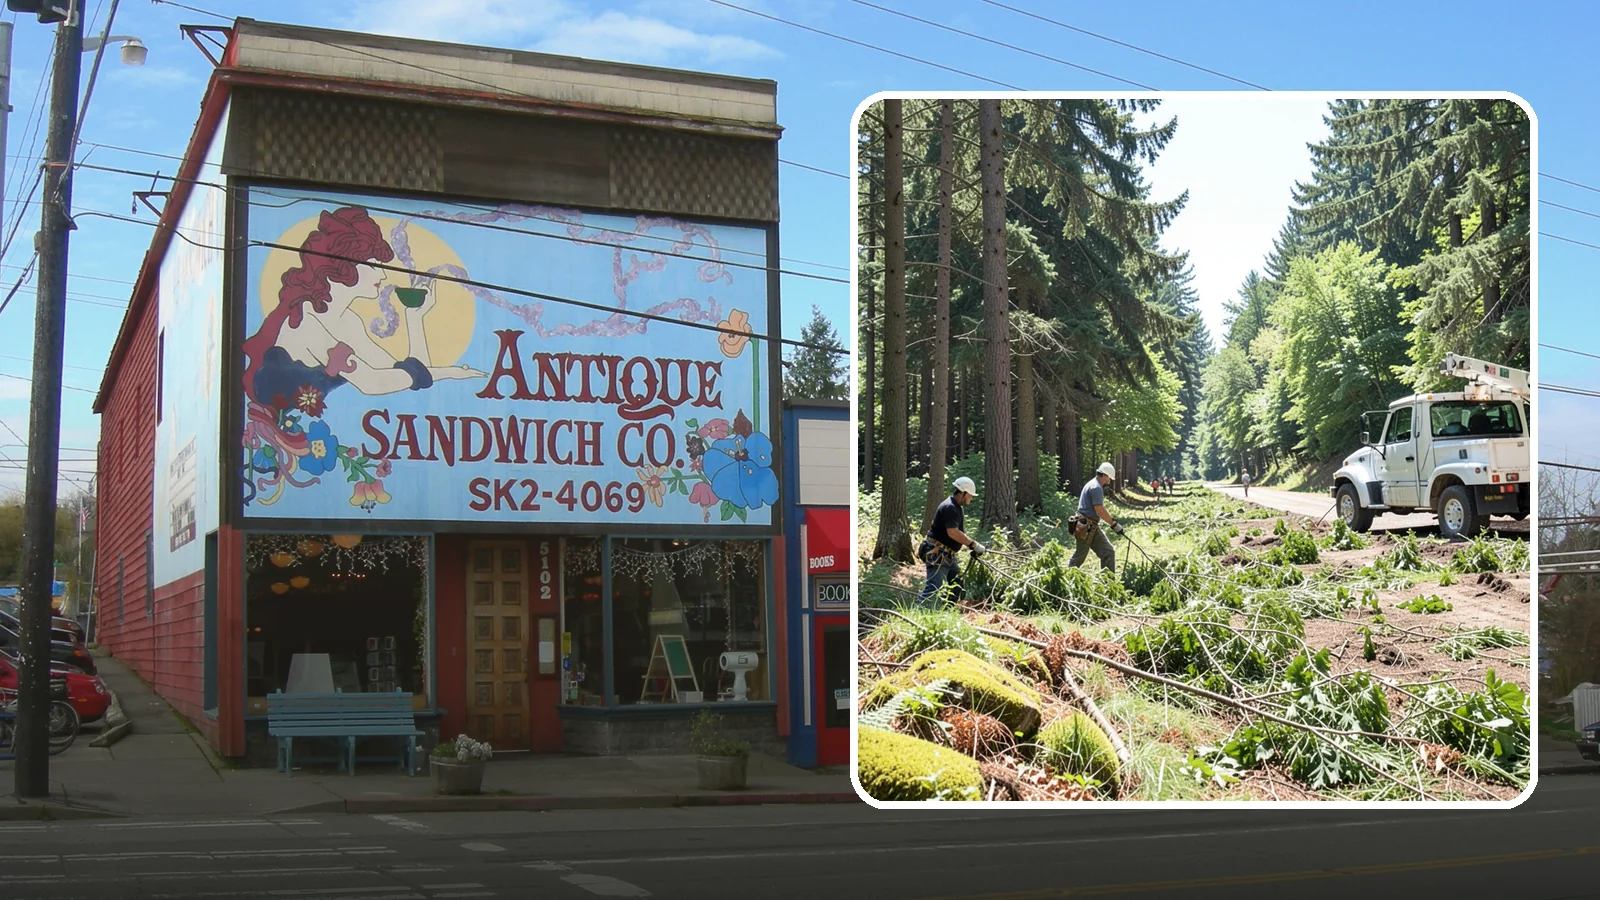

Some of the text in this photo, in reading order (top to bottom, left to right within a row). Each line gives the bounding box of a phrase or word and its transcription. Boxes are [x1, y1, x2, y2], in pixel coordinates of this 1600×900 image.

[361, 408, 684, 469] SANDWICH CO.
[468, 477, 645, 513] SK2-4069
[540, 541, 551, 599] 5102
[809, 555, 835, 569] BOOKS
